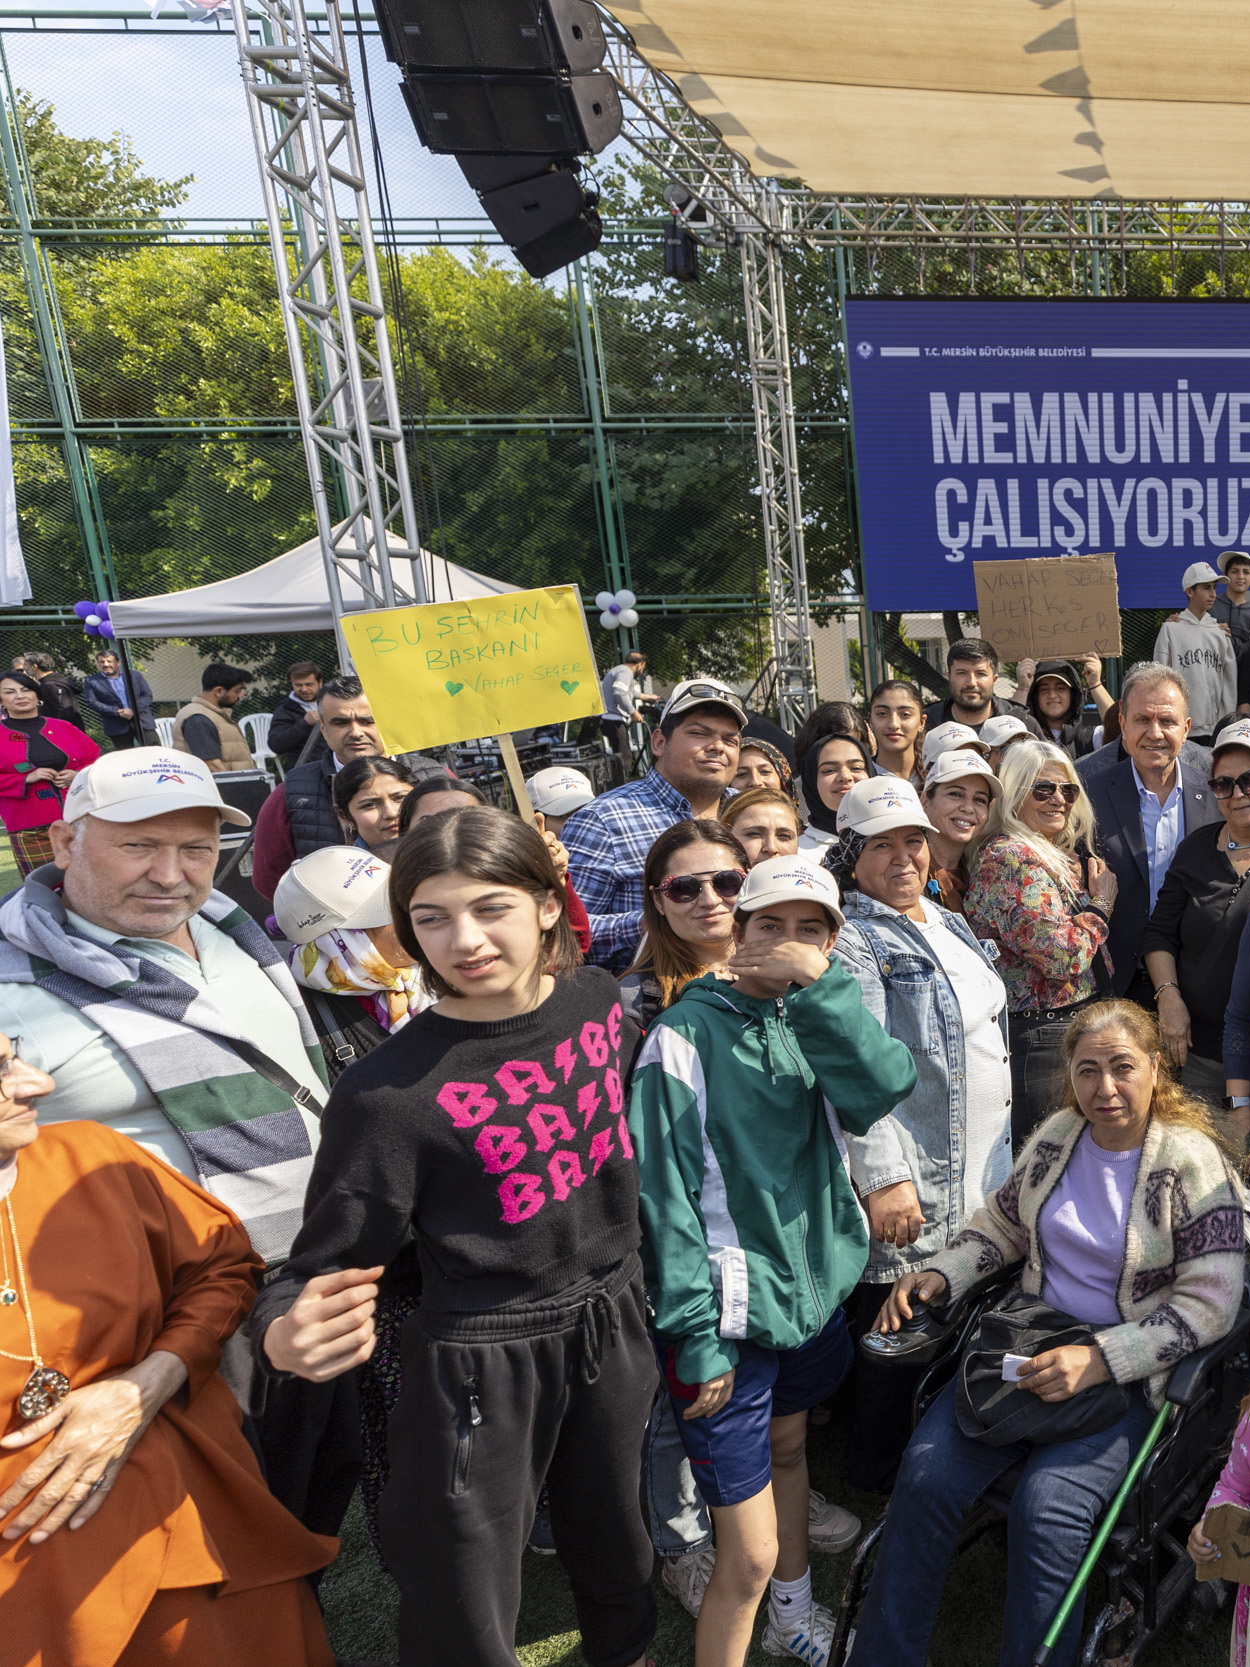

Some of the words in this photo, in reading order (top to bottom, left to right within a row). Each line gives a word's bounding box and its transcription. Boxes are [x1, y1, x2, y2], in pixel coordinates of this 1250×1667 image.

[924, 348, 940, 356] T.C.
[942, 345, 976, 356] MERSİN
[979, 345, 1036, 358] BÜYÜKŞEHİR
[1038, 346, 1086, 357] BELEDİYESİ
[983, 569, 1051, 593] VAHAP
[366, 622, 420, 657] BU
[437, 600, 539, 639] ŞEHRİN
[426, 632, 538, 670] BAŞKANI
[463, 672, 524, 692] VAHAP
